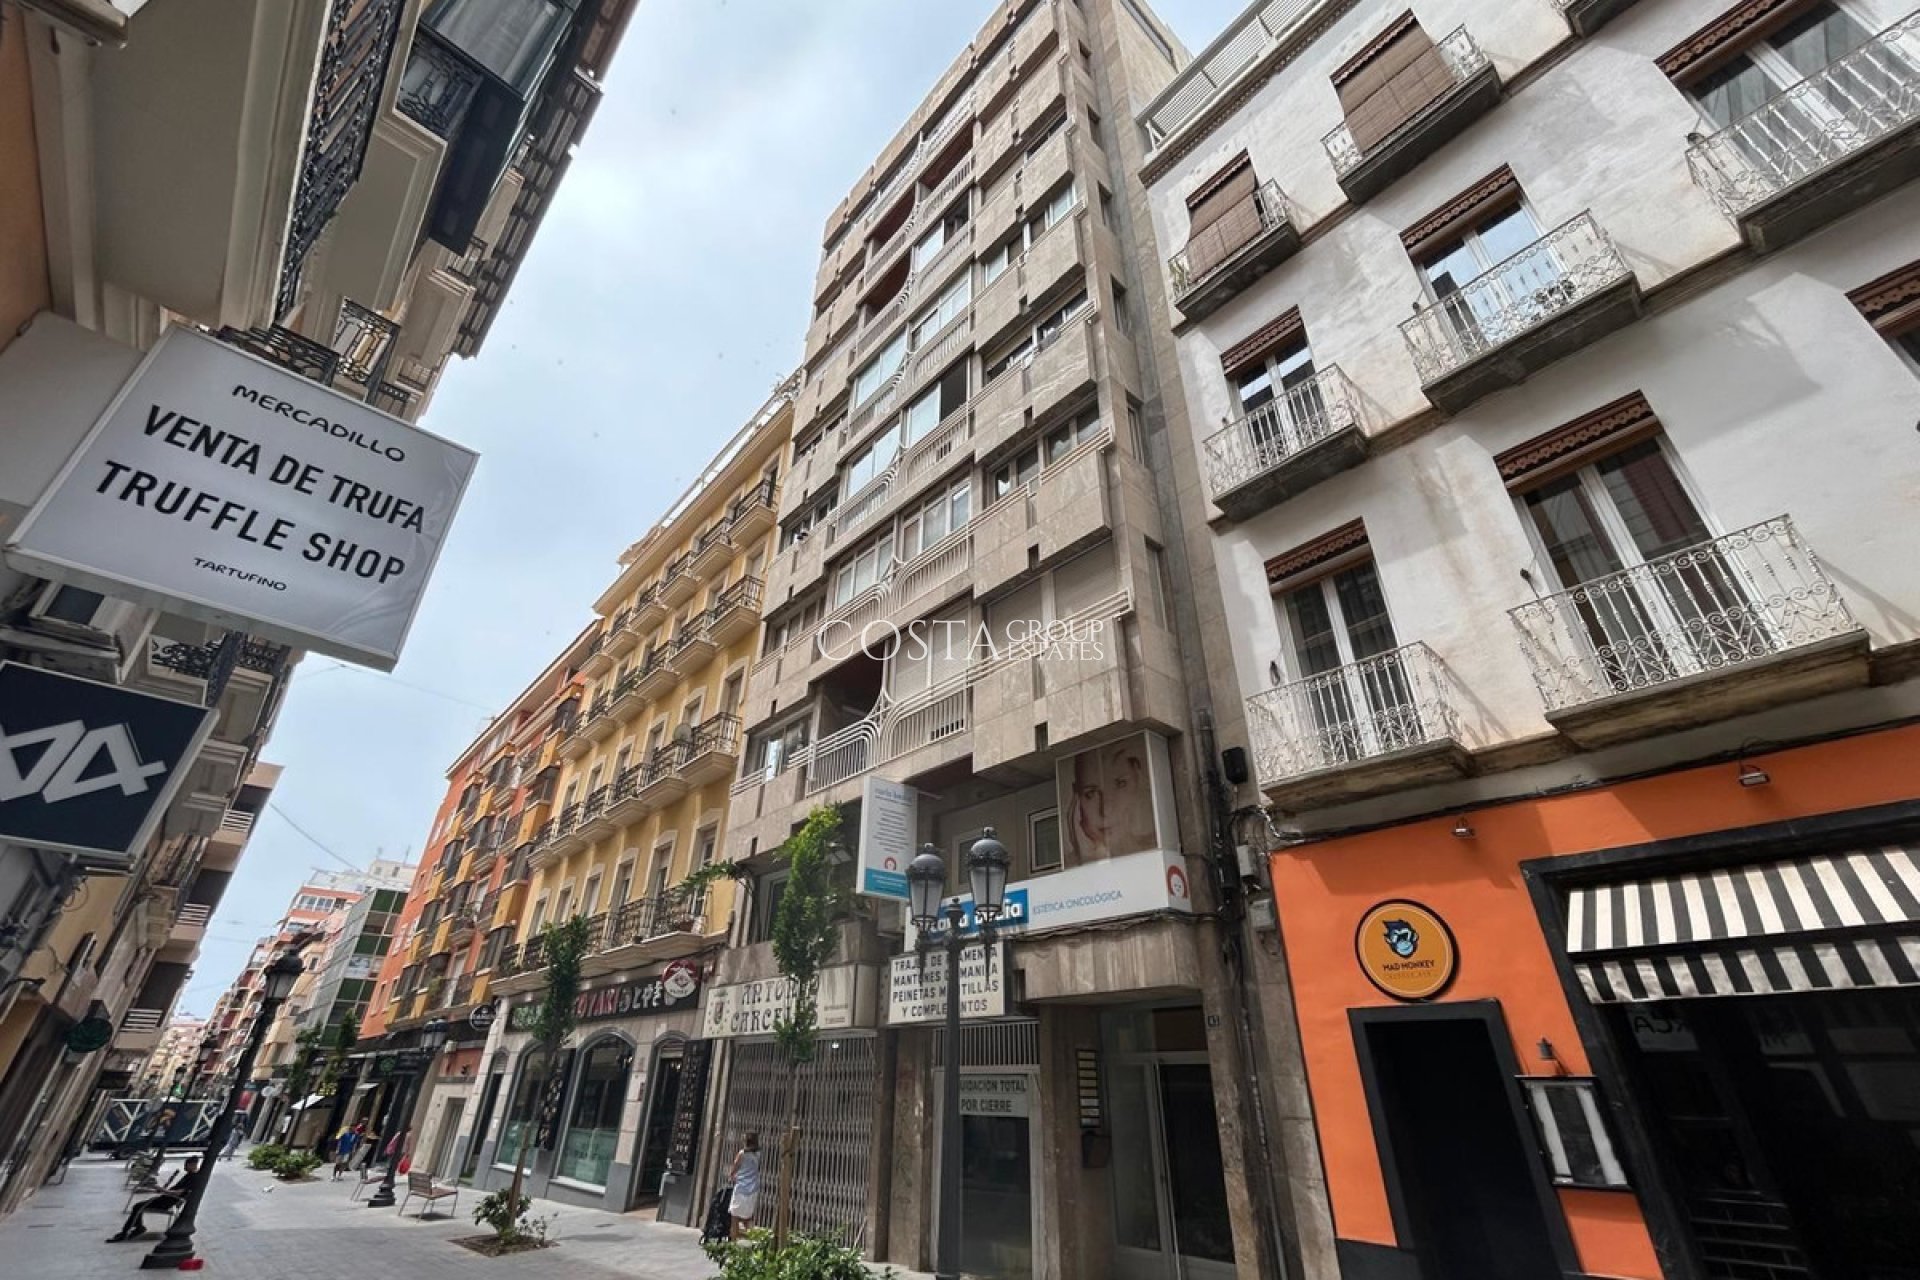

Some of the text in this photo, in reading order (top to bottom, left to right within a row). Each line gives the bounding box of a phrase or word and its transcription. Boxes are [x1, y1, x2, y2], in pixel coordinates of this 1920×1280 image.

[232, 384, 406, 462] MERCADILLO
[143, 404, 426, 534] VENTA DE TRUFA
[96, 460, 405, 585] TRUFFLE SHOP
[193, 556, 287, 592] TARTUFINO
[893, 969, 941, 986] MANTNES
[959, 962, 998, 978] MANIA
[1382, 959, 1434, 973] MAD MONKEY
[893, 980, 999, 1003] PEINETAS MTILLAS
[901, 1007, 908, 1018] Y
[999, 1079, 1027, 1093] TOTAL
[961, 1098, 1013, 1113] POR CIERRE
